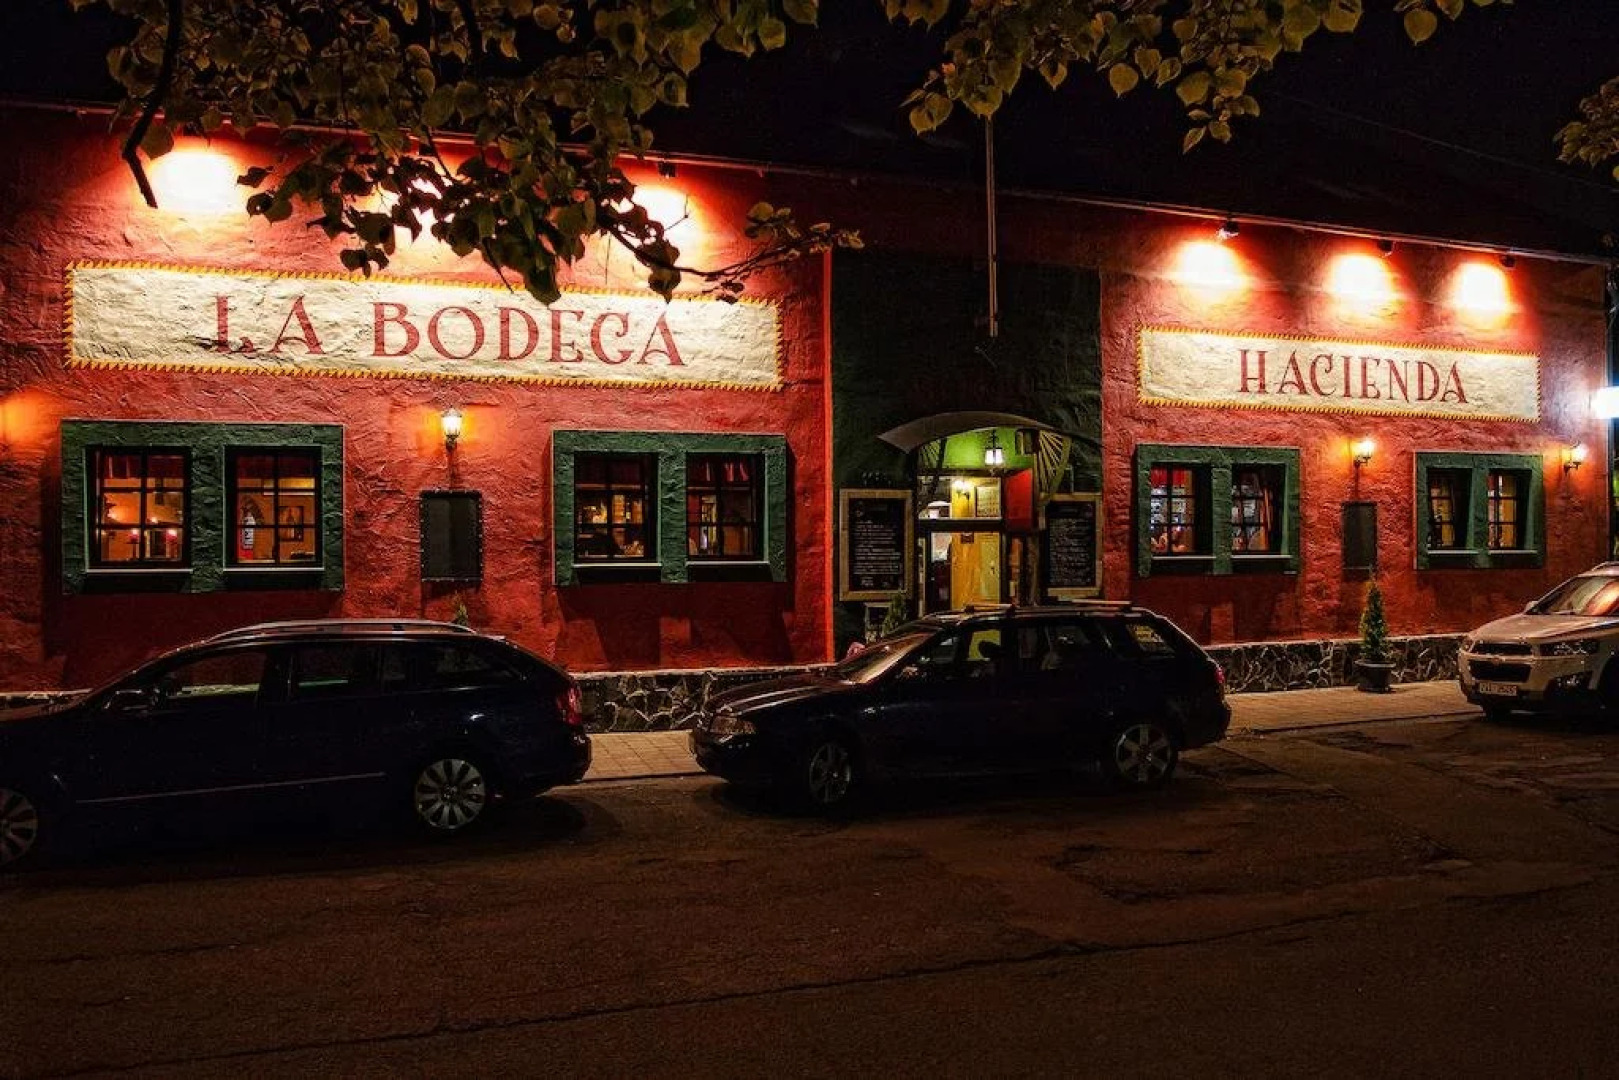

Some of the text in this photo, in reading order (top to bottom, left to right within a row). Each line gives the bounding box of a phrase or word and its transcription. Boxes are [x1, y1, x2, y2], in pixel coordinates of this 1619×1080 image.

[214, 294, 688, 367] LA BODEGA
[1238, 349, 1469, 404] HACIENDA
